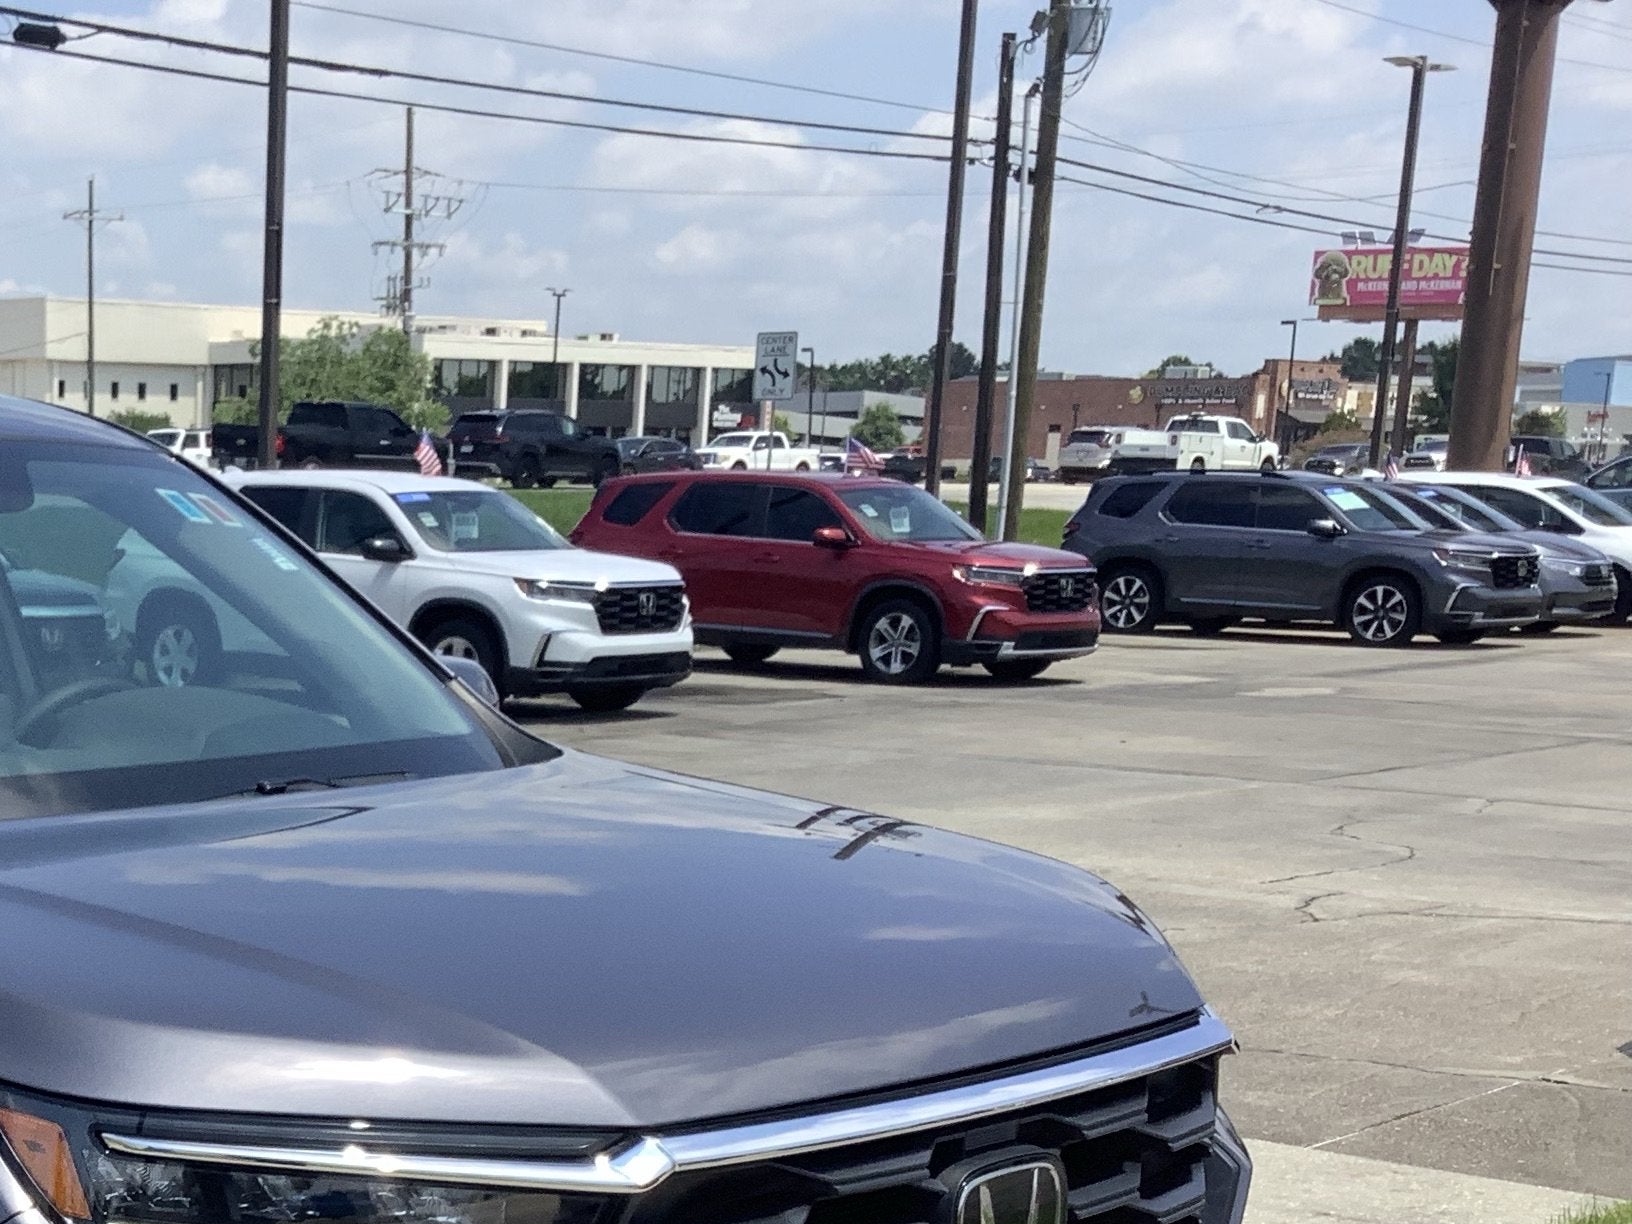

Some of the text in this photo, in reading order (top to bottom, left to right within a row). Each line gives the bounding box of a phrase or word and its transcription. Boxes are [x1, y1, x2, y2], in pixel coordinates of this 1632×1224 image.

[760, 335, 794, 346] CENTER
[764, 345, 787, 354] LANE
[761, 388, 785, 397] ONLY
